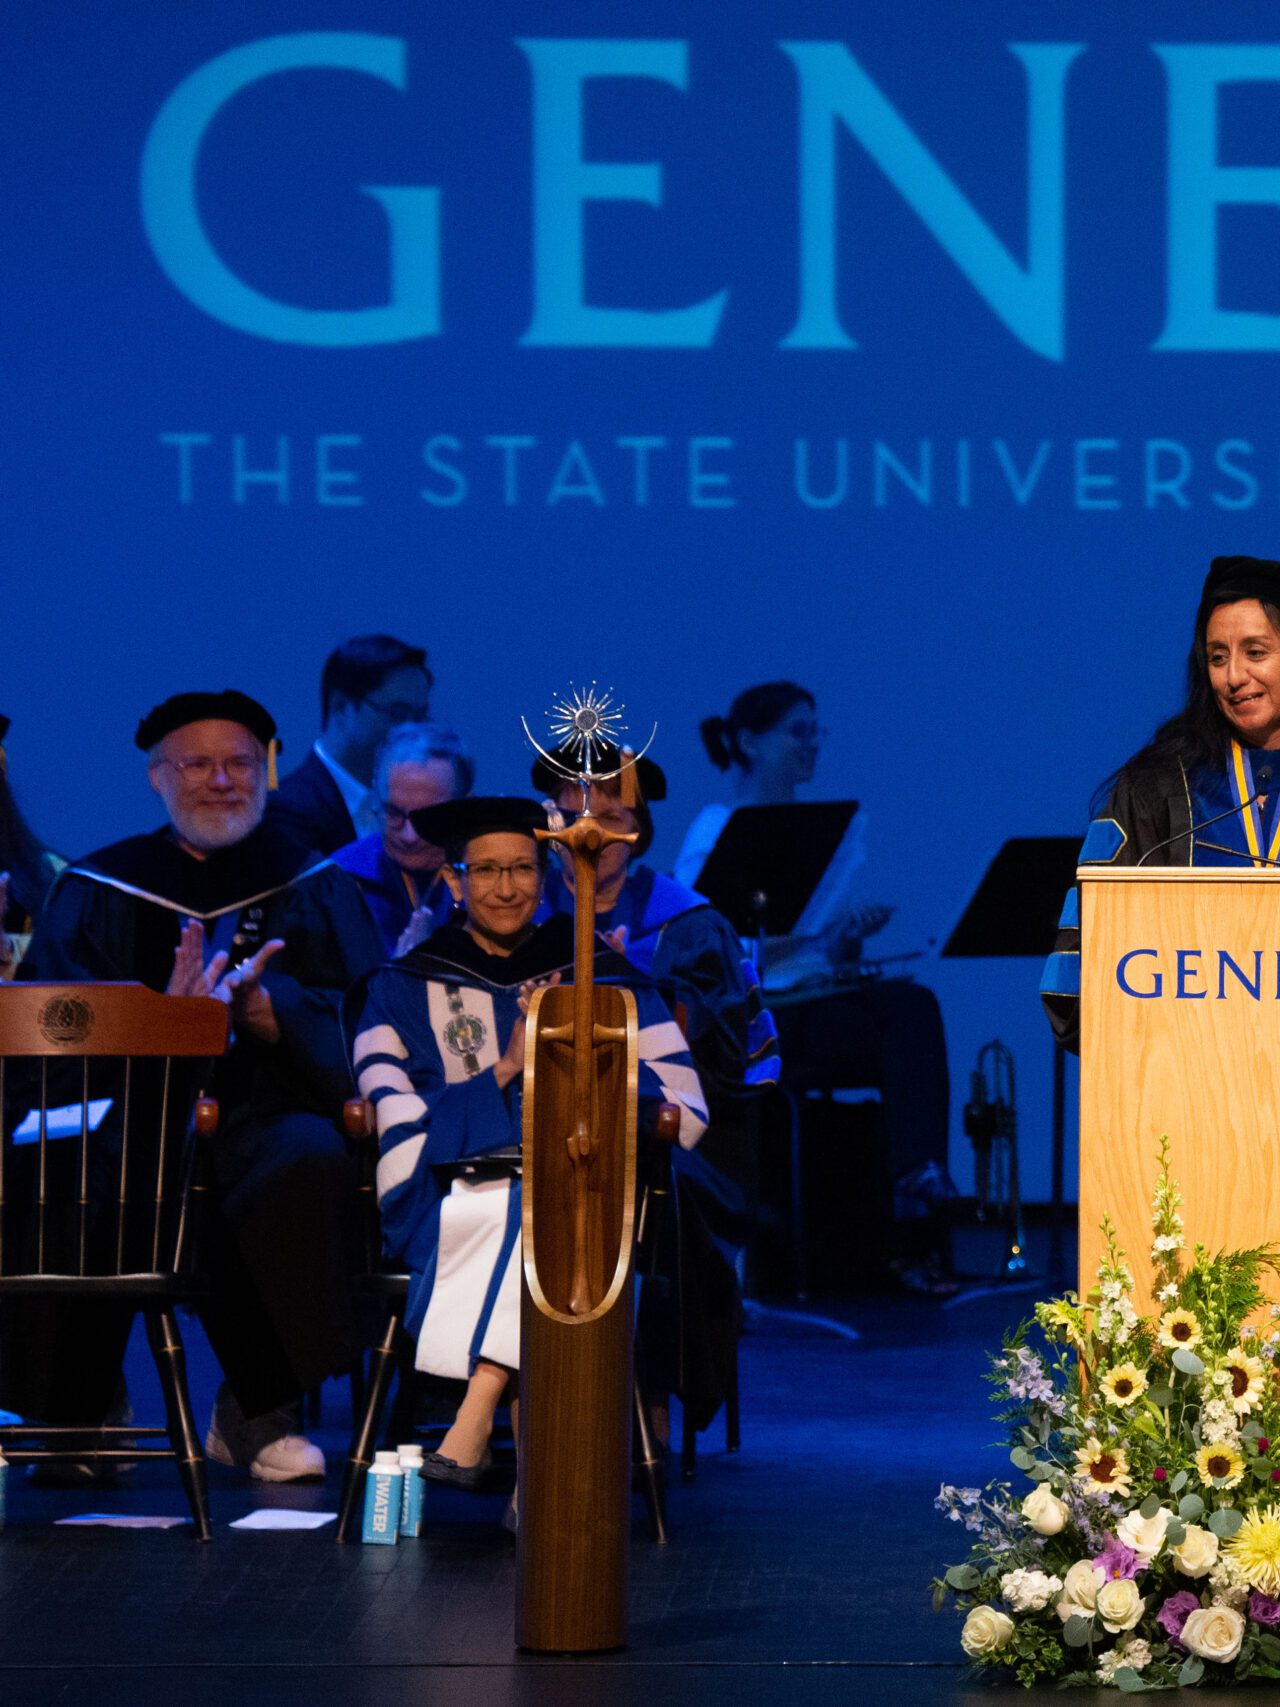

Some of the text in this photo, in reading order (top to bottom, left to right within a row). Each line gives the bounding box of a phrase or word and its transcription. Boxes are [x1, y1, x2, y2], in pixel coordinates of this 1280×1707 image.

[160, 433, 363, 508] THE
[422, 434, 738, 510] STATE
[373, 1482, 390, 1533] WATER
